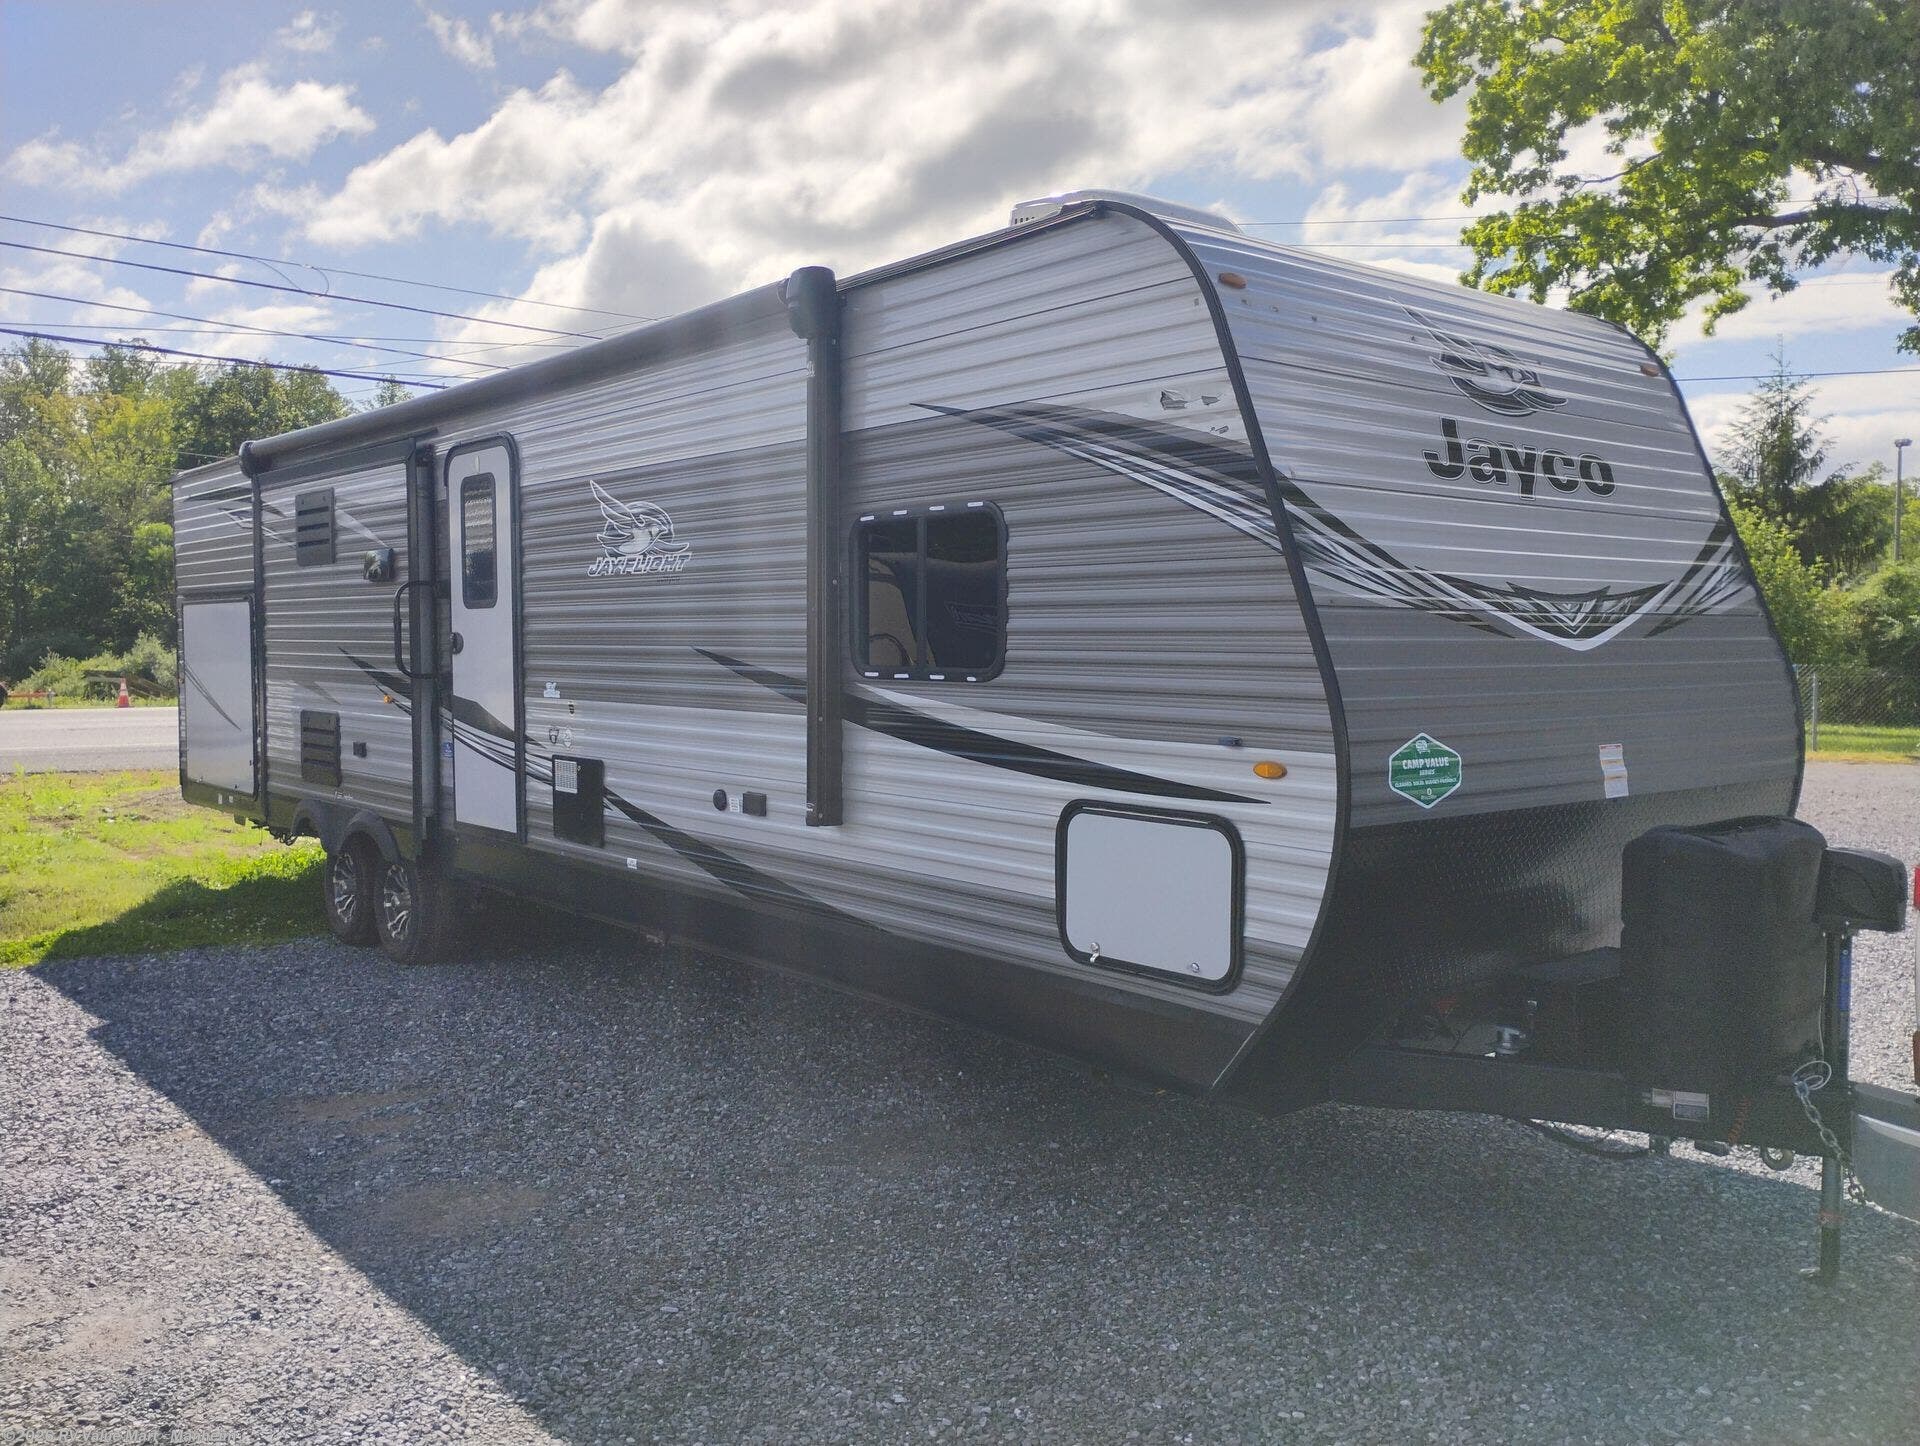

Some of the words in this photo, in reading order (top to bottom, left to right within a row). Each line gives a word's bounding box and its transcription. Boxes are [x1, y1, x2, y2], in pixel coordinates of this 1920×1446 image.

[1422, 416, 1617, 500] Jayco
[1402, 759, 1424, 769] CAMP
[1425, 757, 1450, 768] VALUE
